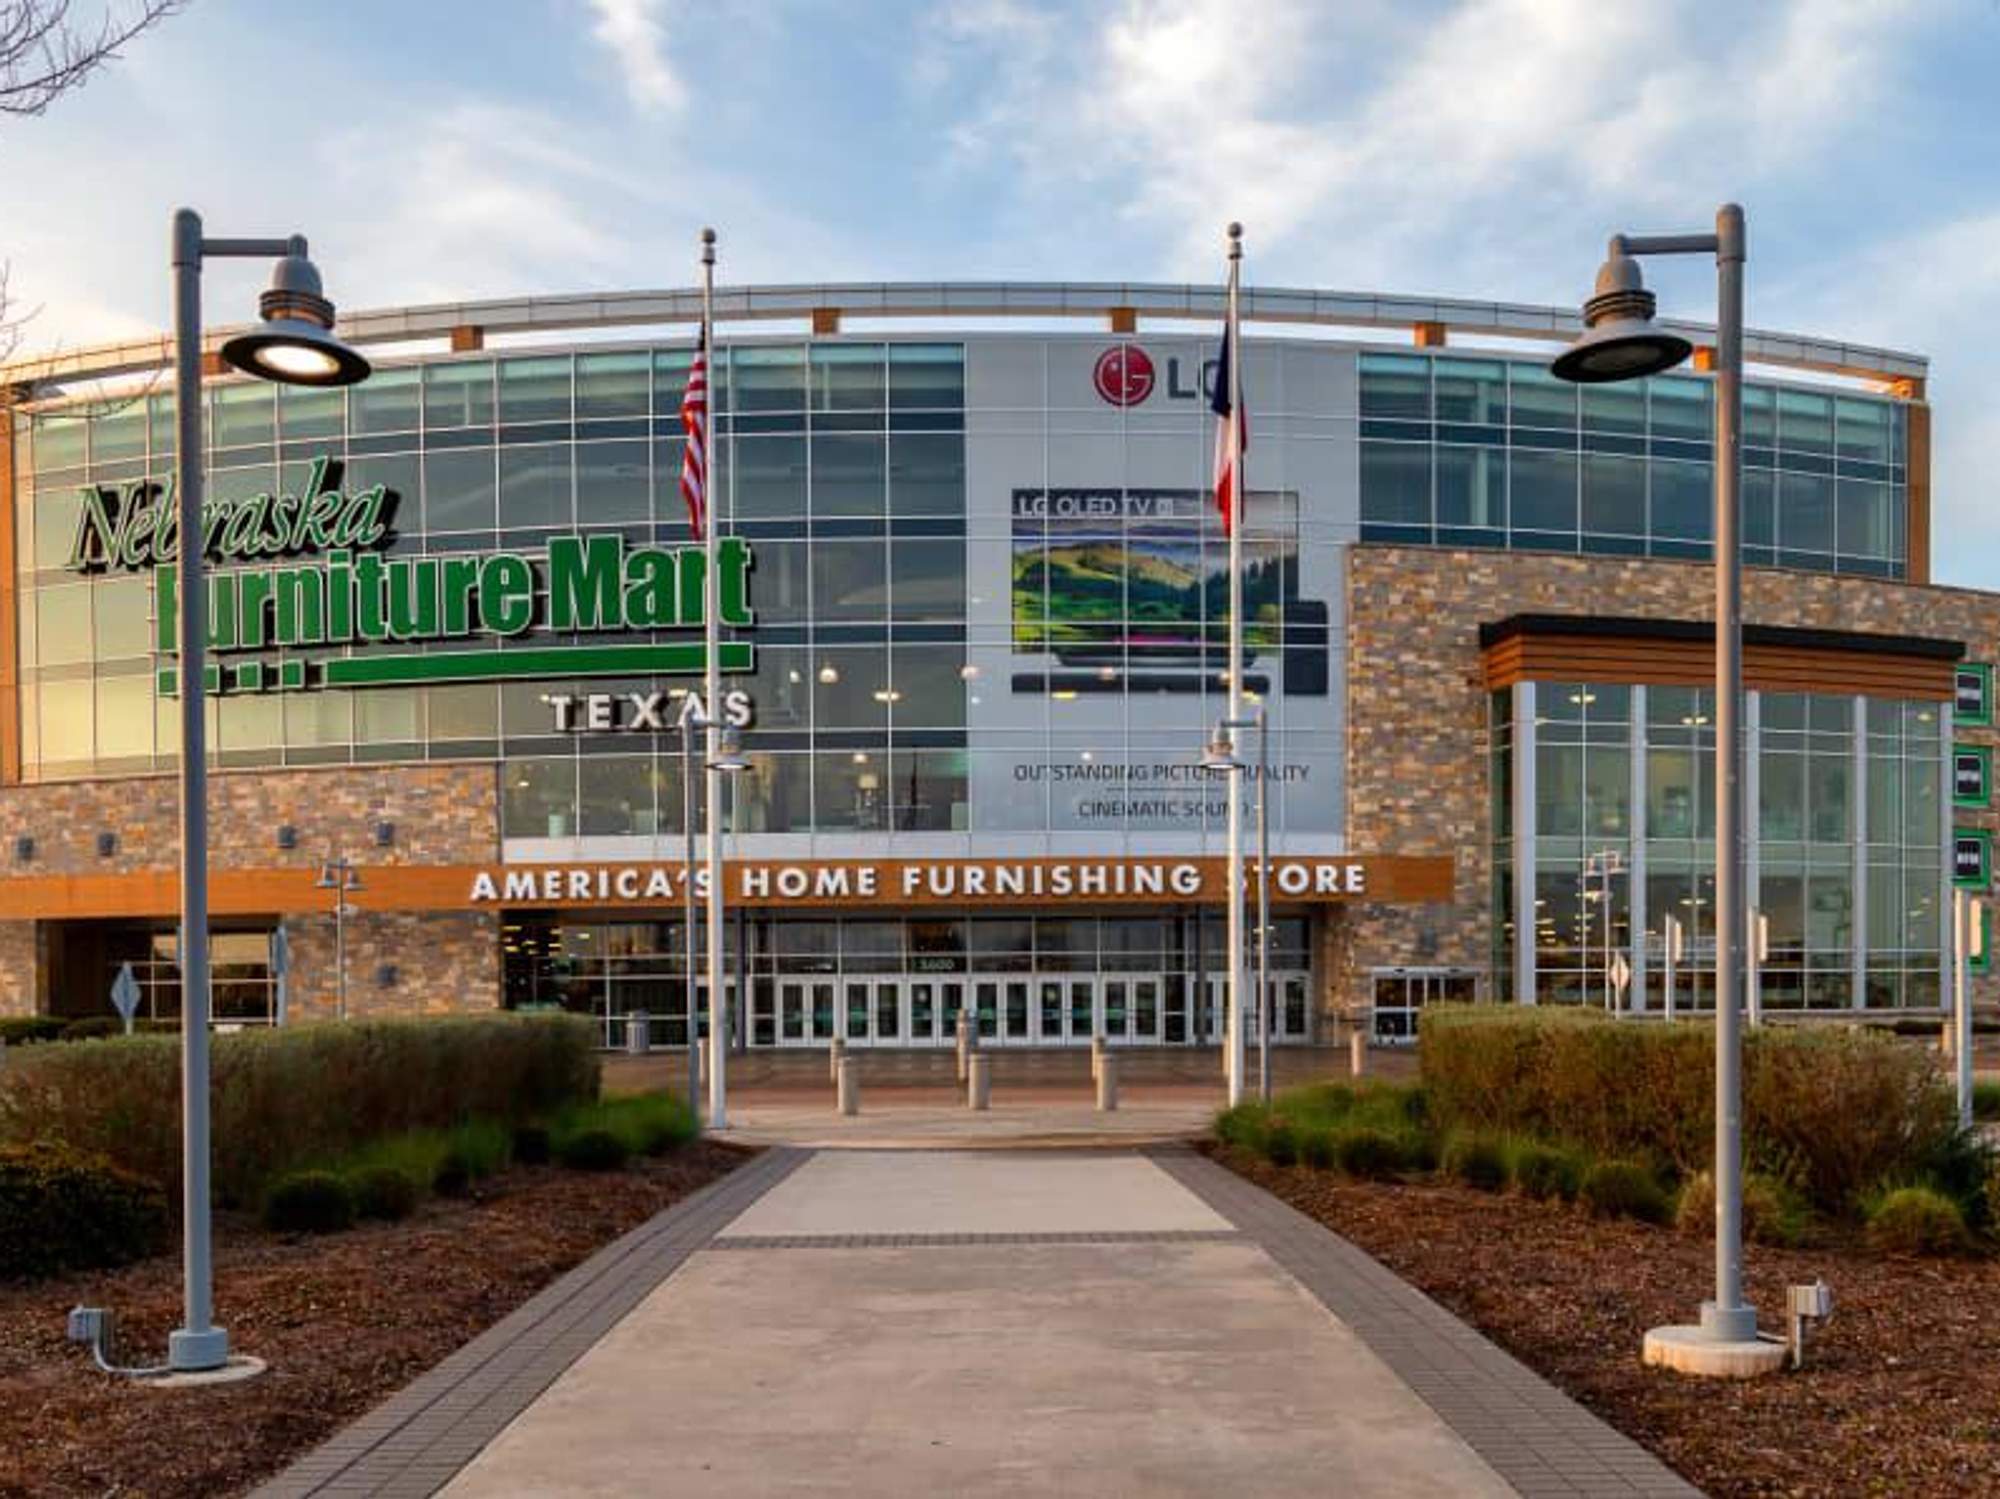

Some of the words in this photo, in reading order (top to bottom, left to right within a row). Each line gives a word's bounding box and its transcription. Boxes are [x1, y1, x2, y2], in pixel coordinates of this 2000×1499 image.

[1019, 495, 1048, 516] LG
[1056, 496, 1116, 516] OLED
[1122, 497, 1152, 516] TV
[547, 533, 753, 632] Mart
[550, 691, 751, 731] TEXAS
[1014, 764, 1149, 782] OUTSTANDING
[1236, 764, 1310, 784] ULITY
[1079, 801, 1177, 817] CINEMATIC
[470, 868, 713, 900] AMERICA'S
[741, 867, 877, 897] HOME
[903, 864, 1202, 895] FURNISHING
[1228, 863, 1366, 895] ORE
